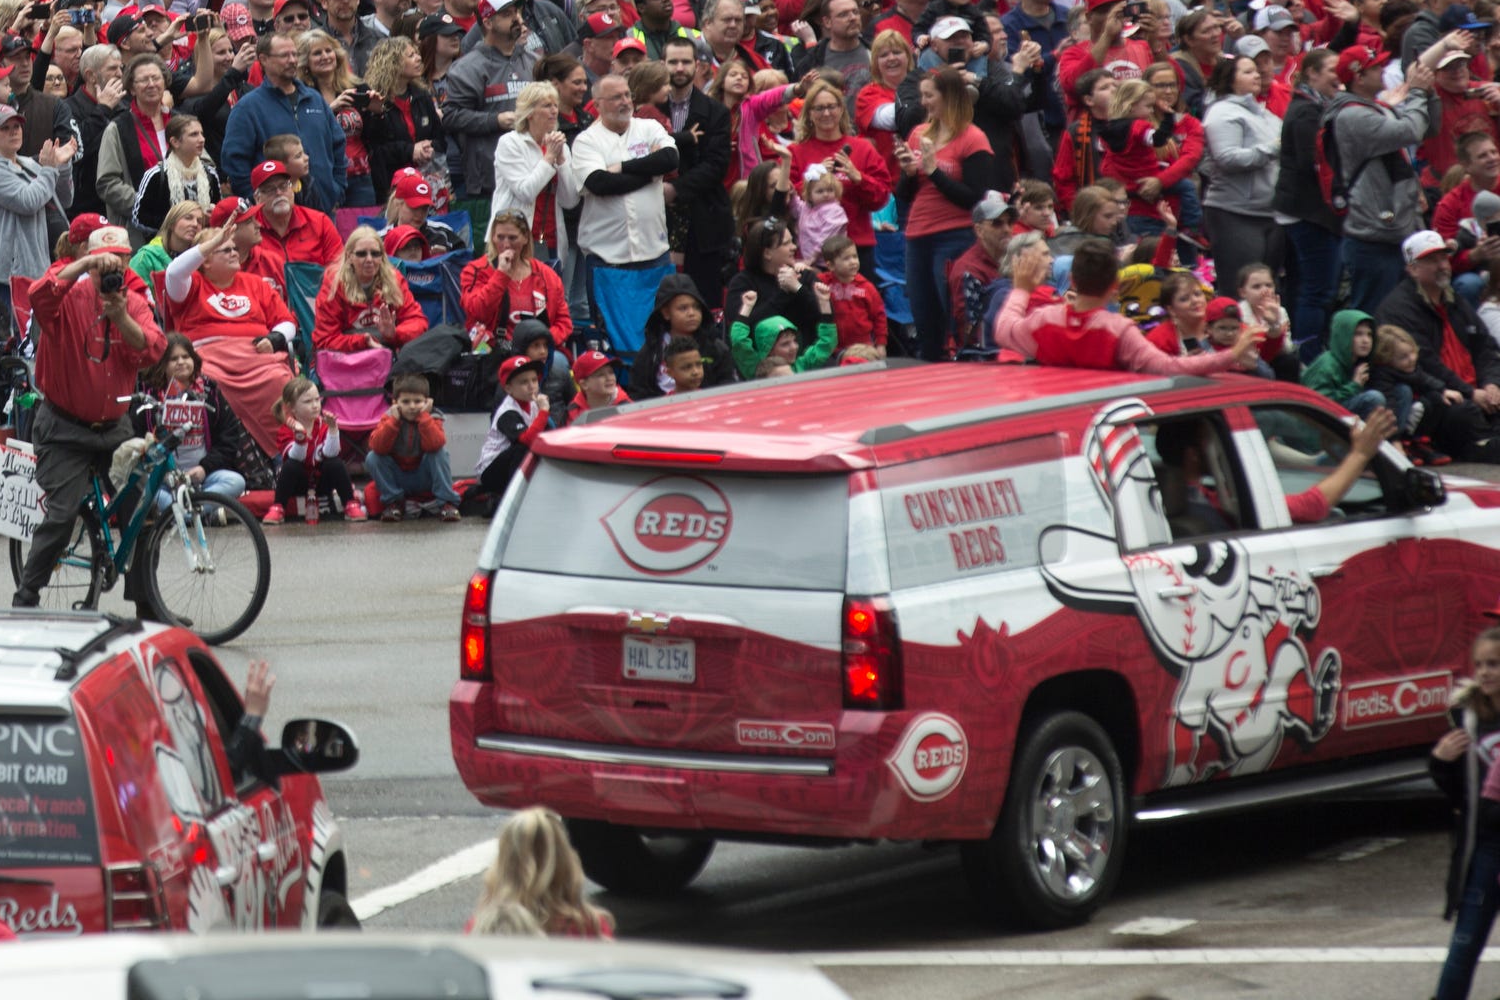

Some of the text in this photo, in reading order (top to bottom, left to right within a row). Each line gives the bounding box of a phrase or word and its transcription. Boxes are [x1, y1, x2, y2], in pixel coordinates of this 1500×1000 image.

[904, 478, 1023, 532] CINCINNATI
[638, 510, 728, 540] REDS
[949, 524, 1007, 571] REDS
[628, 646, 689, 671] HAL 2154
[916, 744, 964, 770] REDS
[24, 764, 68, 785] CARD
[34, 795, 87, 816] branch
